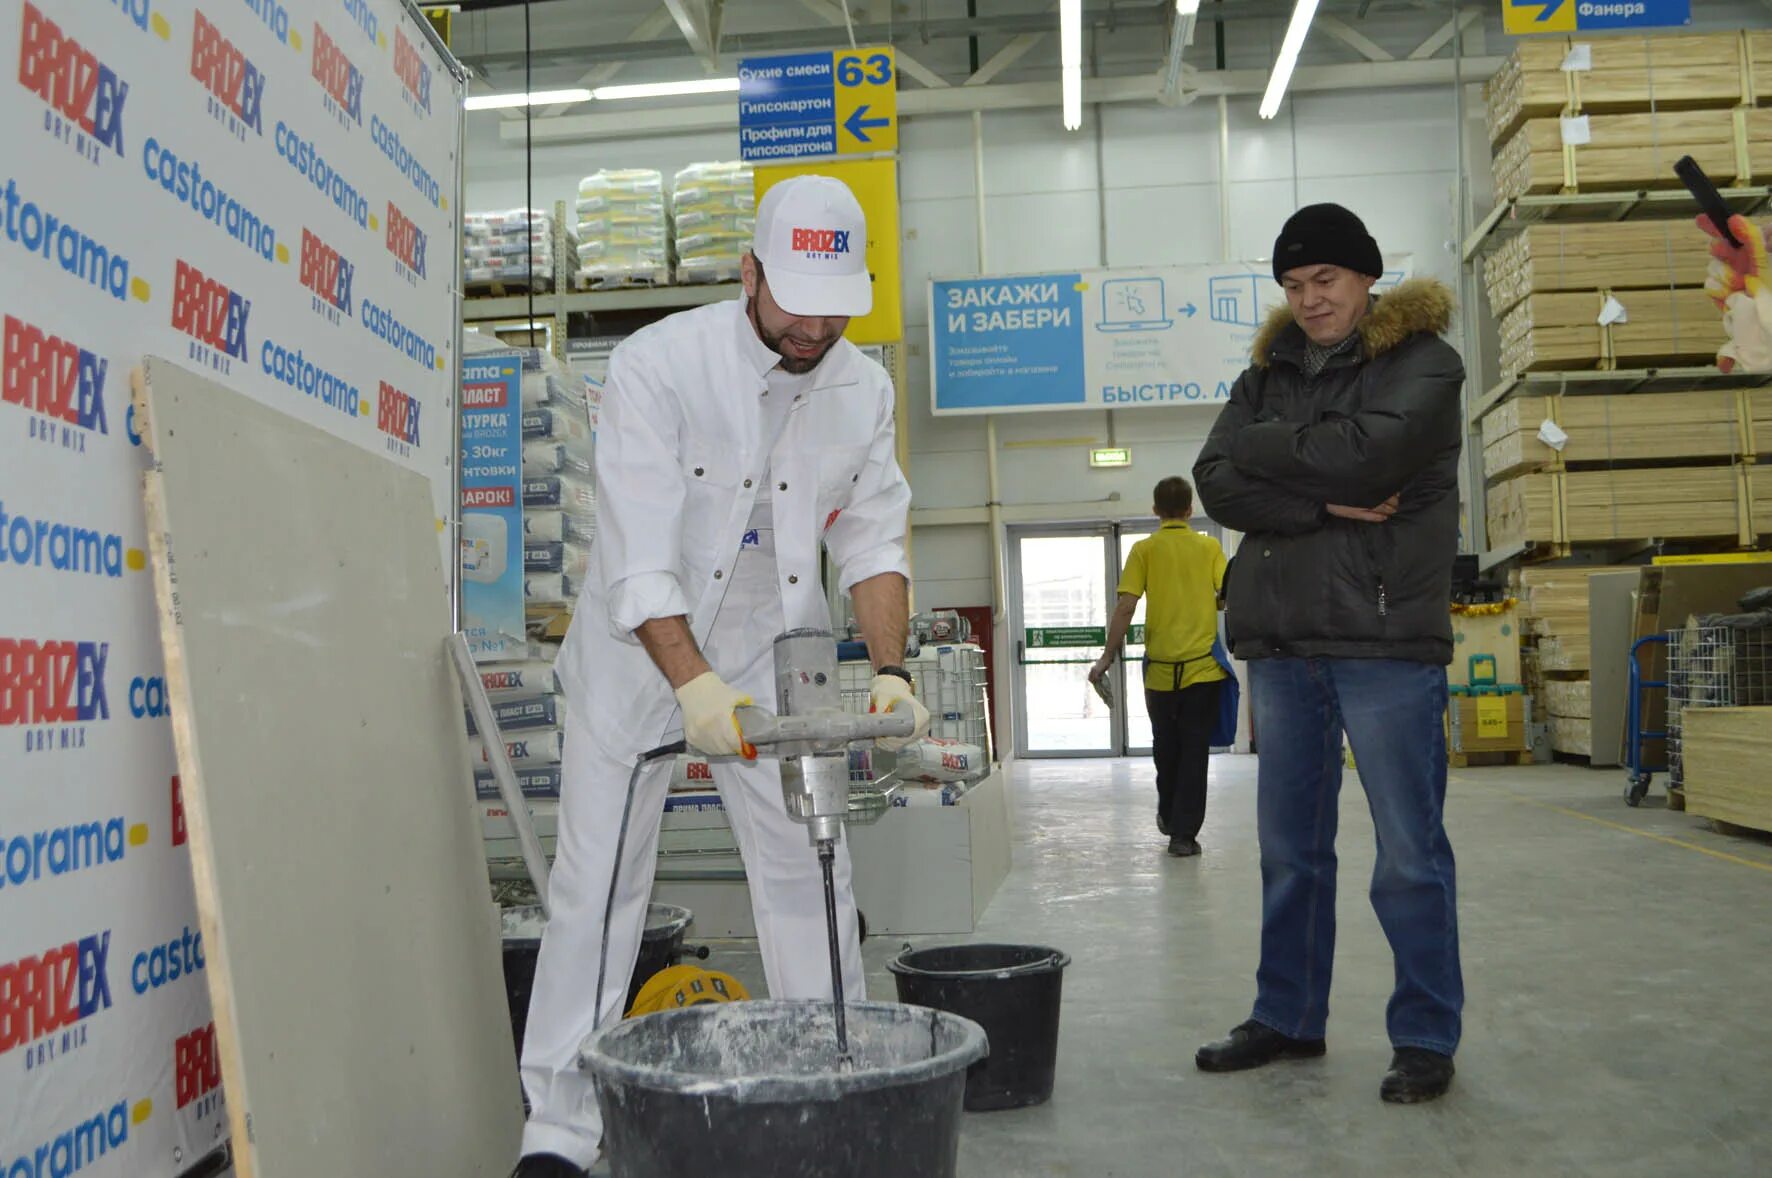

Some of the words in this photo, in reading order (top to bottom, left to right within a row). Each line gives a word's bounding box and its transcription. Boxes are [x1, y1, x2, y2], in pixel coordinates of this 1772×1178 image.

[1578, 2, 1645, 19] Фанера
[18, 0, 129, 158] BROZEX
[190, 7, 265, 137] BROZEX
[312, 20, 364, 128] BROZEX
[394, 23, 432, 116] BROZEX
[739, 67, 783, 82] Сухие
[786, 63, 830, 78] смеси
[837, 54, 893, 87] 63
[44, 109, 71, 145] DRY
[76, 132, 101, 166] MIX
[741, 97, 832, 115] Гипсокартон
[742, 126, 804, 143] Профили
[806, 124, 833, 138] для
[274, 120, 368, 230] castorama
[370, 113, 439, 209] castorama
[742, 139, 833, 158] гипсокартона
[143, 136, 275, 263] castorama
[0, 177, 129, 301] torama
[299, 224, 354, 319] BROZEX
[386, 199, 428, 281] BROZEX
[791, 228, 850, 253] BROZEX
[171, 258, 252, 364] BROZEX
[947, 282, 1059, 309] ЗАКАЖИ
[948, 312, 966, 333] И
[972, 307, 1072, 333] ЗАБЕРИ
[362, 298, 435, 371] castorama
[2, 312, 109, 436] BROZEX
[261, 339, 359, 417] castorama
[1102, 382, 1208, 403] БЫСТРО.
[1214, 380, 1231, 399] Л
[29, 414, 57, 444] DRY
[61, 425, 86, 455] MIX
[377, 380, 421, 448] BROZEX
[463, 490, 510, 506] АРОК!
[0, 637, 110, 726] BROZEX
[26, 728, 54, 753] DRY
[60, 727, 86, 750] MIX
